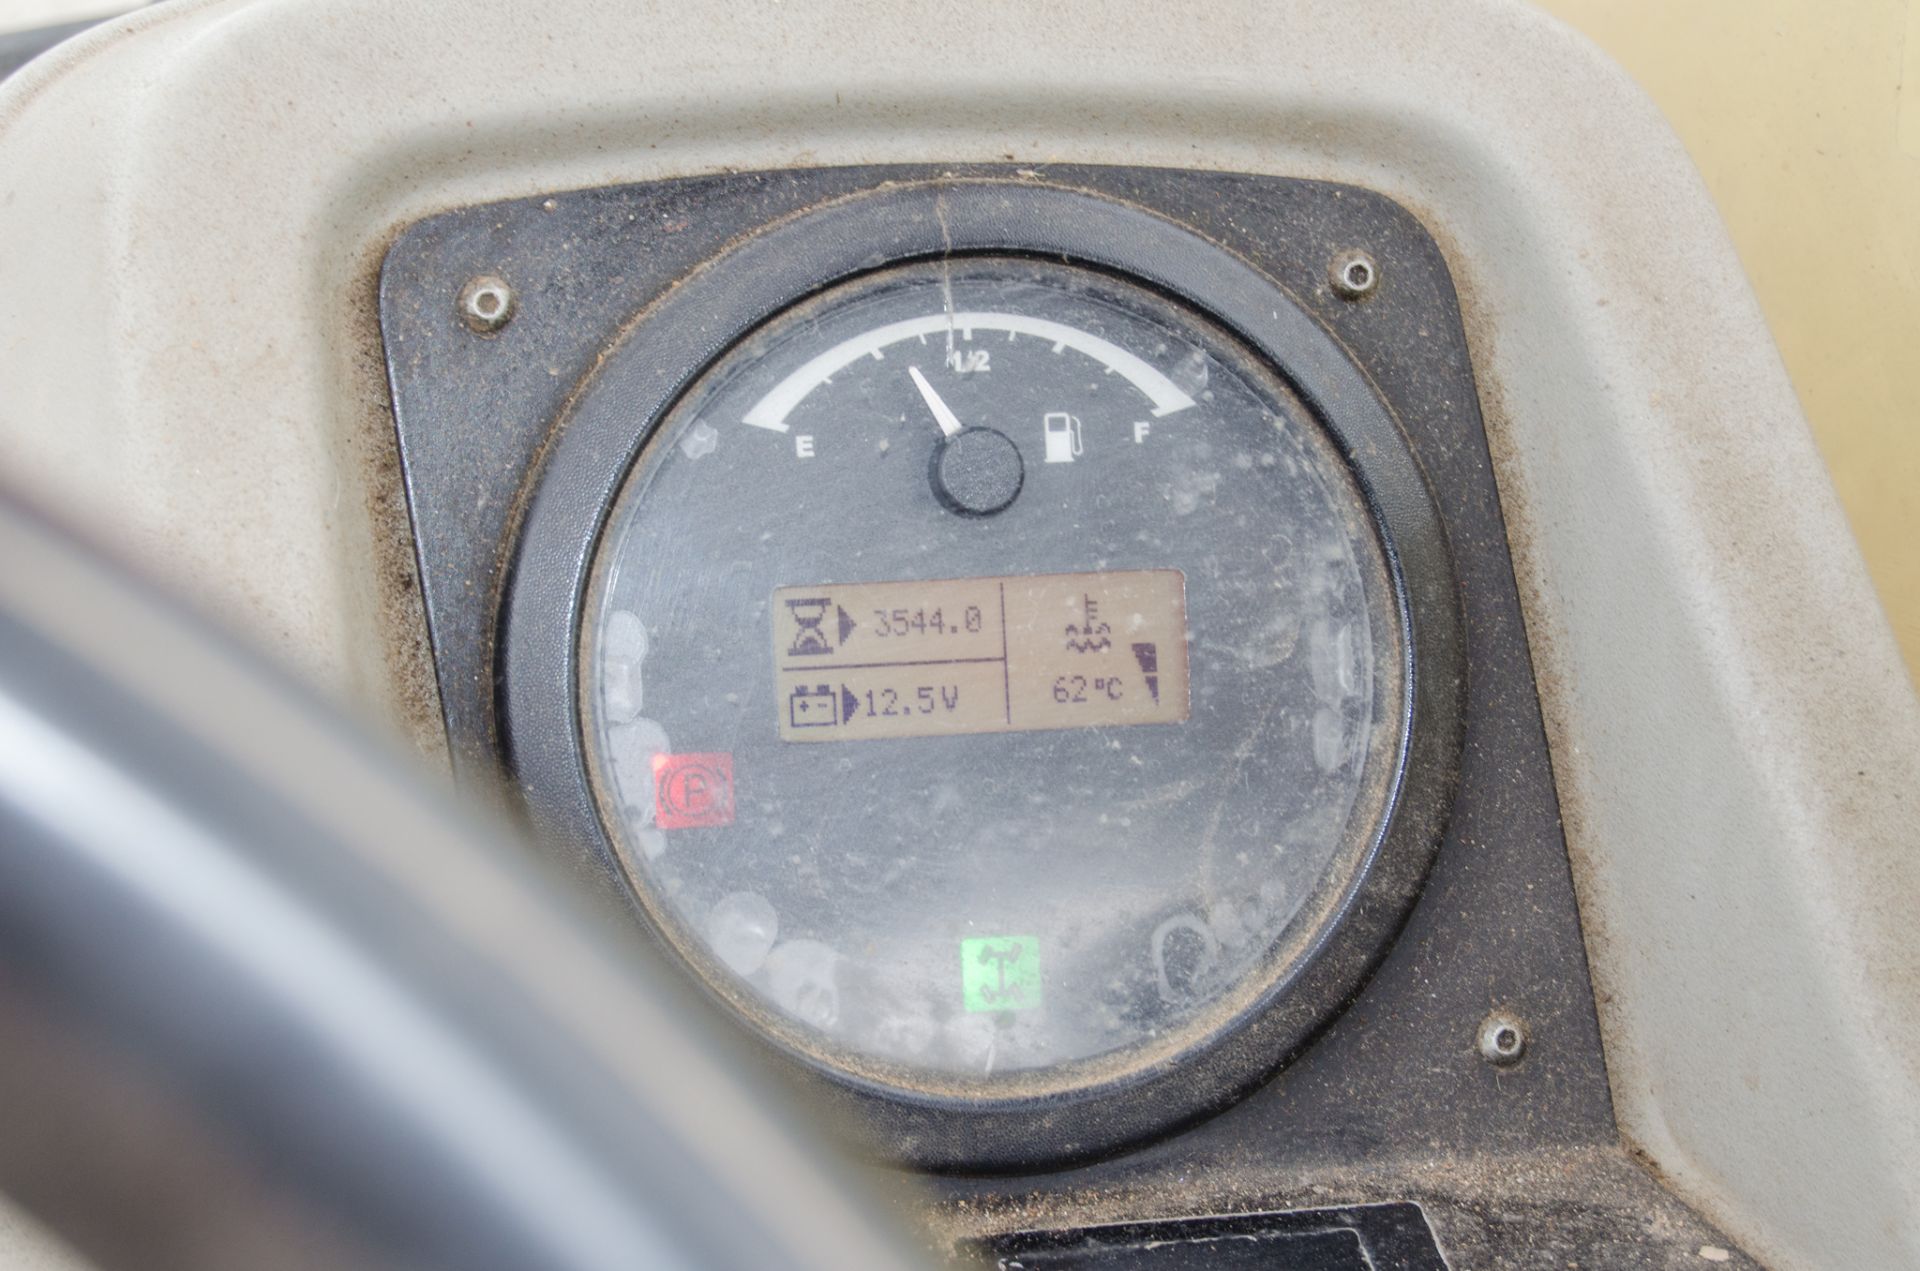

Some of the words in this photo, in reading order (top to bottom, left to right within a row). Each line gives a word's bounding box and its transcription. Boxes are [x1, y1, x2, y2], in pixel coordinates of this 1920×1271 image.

[795, 435, 815, 458] E
[1134, 421, 1151, 444] F
[873, 606, 983, 637] 3544.0
[865, 685, 959, 717] 12.5V
[1052, 676, 1124, 703] 62°C
[684, 773, 707, 808] P
